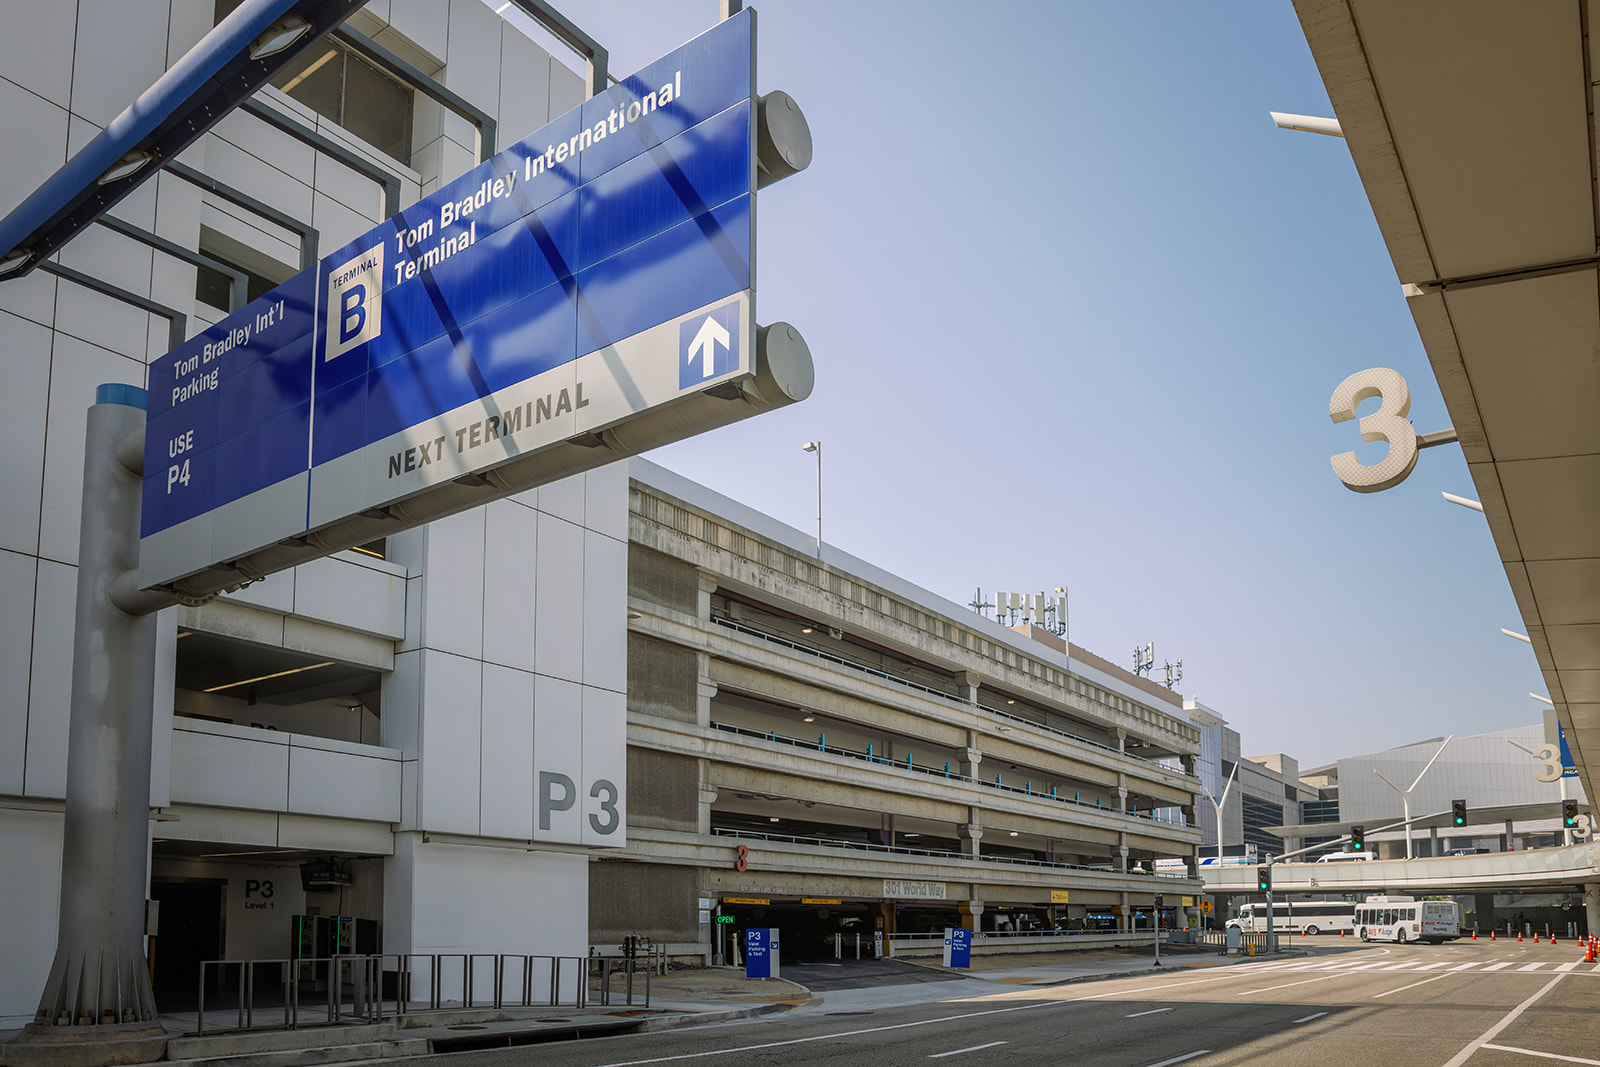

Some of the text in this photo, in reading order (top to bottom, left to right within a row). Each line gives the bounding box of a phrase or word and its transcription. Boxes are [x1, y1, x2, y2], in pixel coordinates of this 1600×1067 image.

[395, 70, 682, 254] Tom Bradley International
[394, 221, 476, 285] Terminal
[332, 256, 378, 290] TERMINAL
[339, 283, 367, 346] B
[173, 354, 199, 380] Tom
[202, 322, 252, 365] Bradley
[171, 366, 220, 407] Parking
[169, 429, 194, 458] USE
[388, 381, 590, 480] NEXT TERMINAL
[1329, 367, 1420, 494] 3
[167, 458, 191, 495] P4
[1533, 743, 1564, 783] 3
[1571, 814, 1591, 839] 3
[734, 844, 749, 873] 3
[245, 879, 274, 899] P3
[245, 901, 274, 910] Level 1
[885, 880, 945, 898] 301 World Way
[717, 916, 734, 924] OPEN
[748, 931, 761, 941] P3
[953, 930, 965, 939] P3
